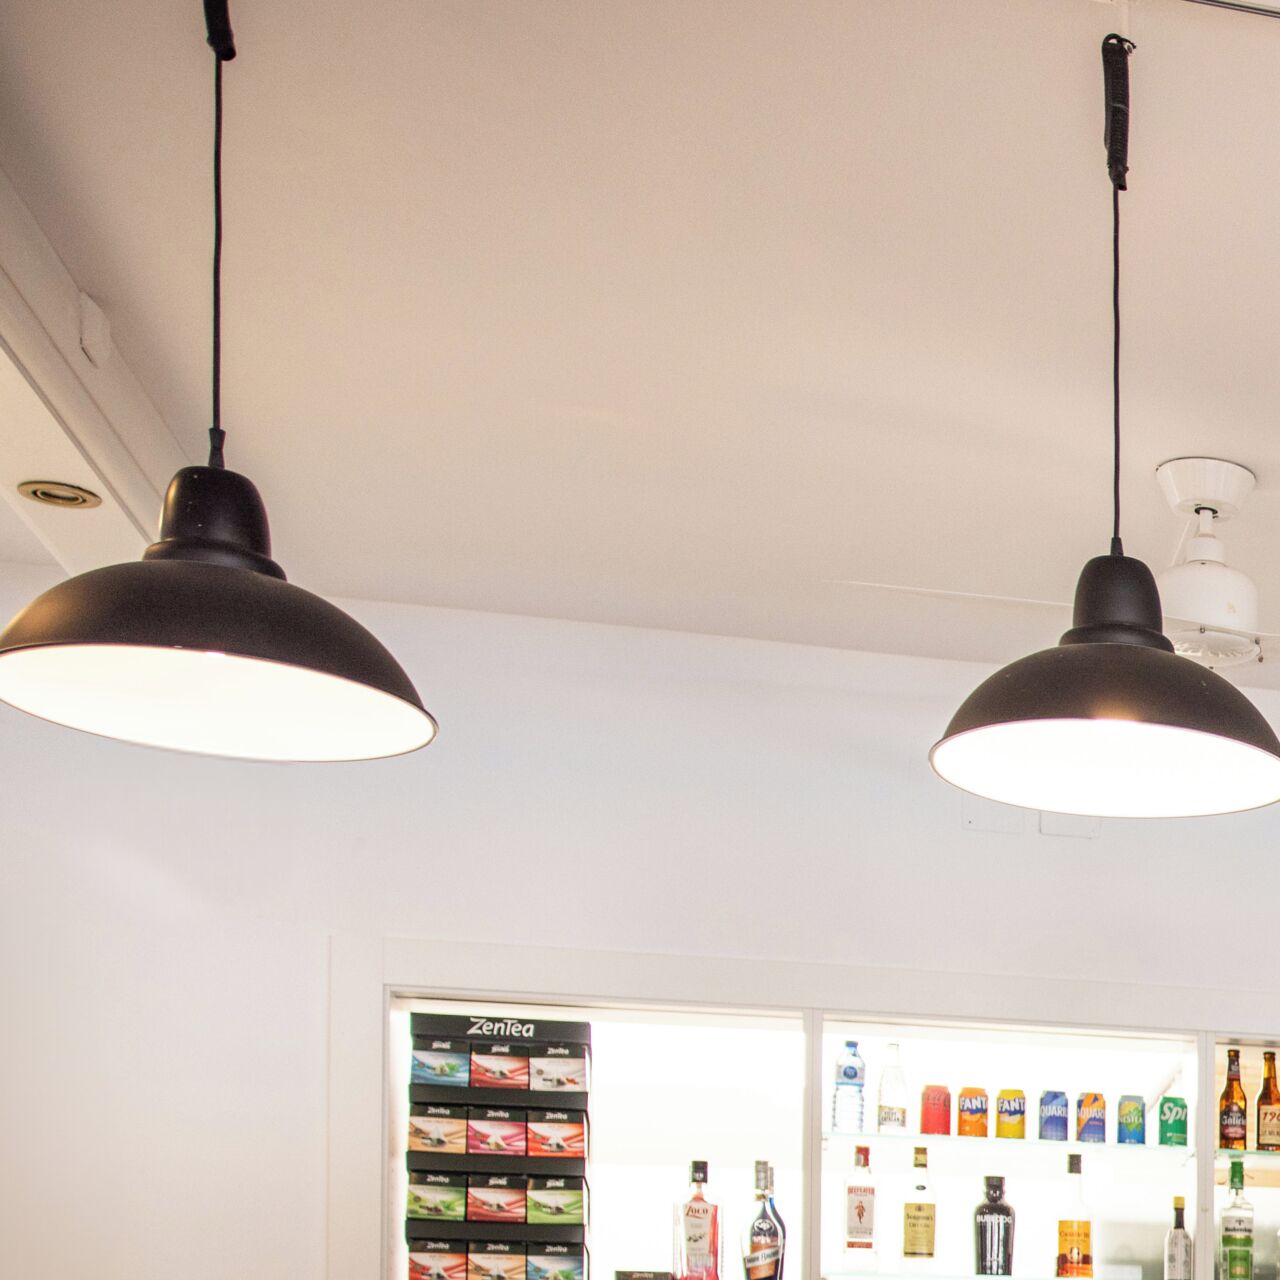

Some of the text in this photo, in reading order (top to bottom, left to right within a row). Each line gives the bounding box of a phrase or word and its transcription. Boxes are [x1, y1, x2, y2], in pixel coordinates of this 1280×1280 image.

[466, 1017, 535, 1038] ZenTea
[959, 1096, 987, 1110] FANT
[998, 1098, 1026, 1112] FANT
